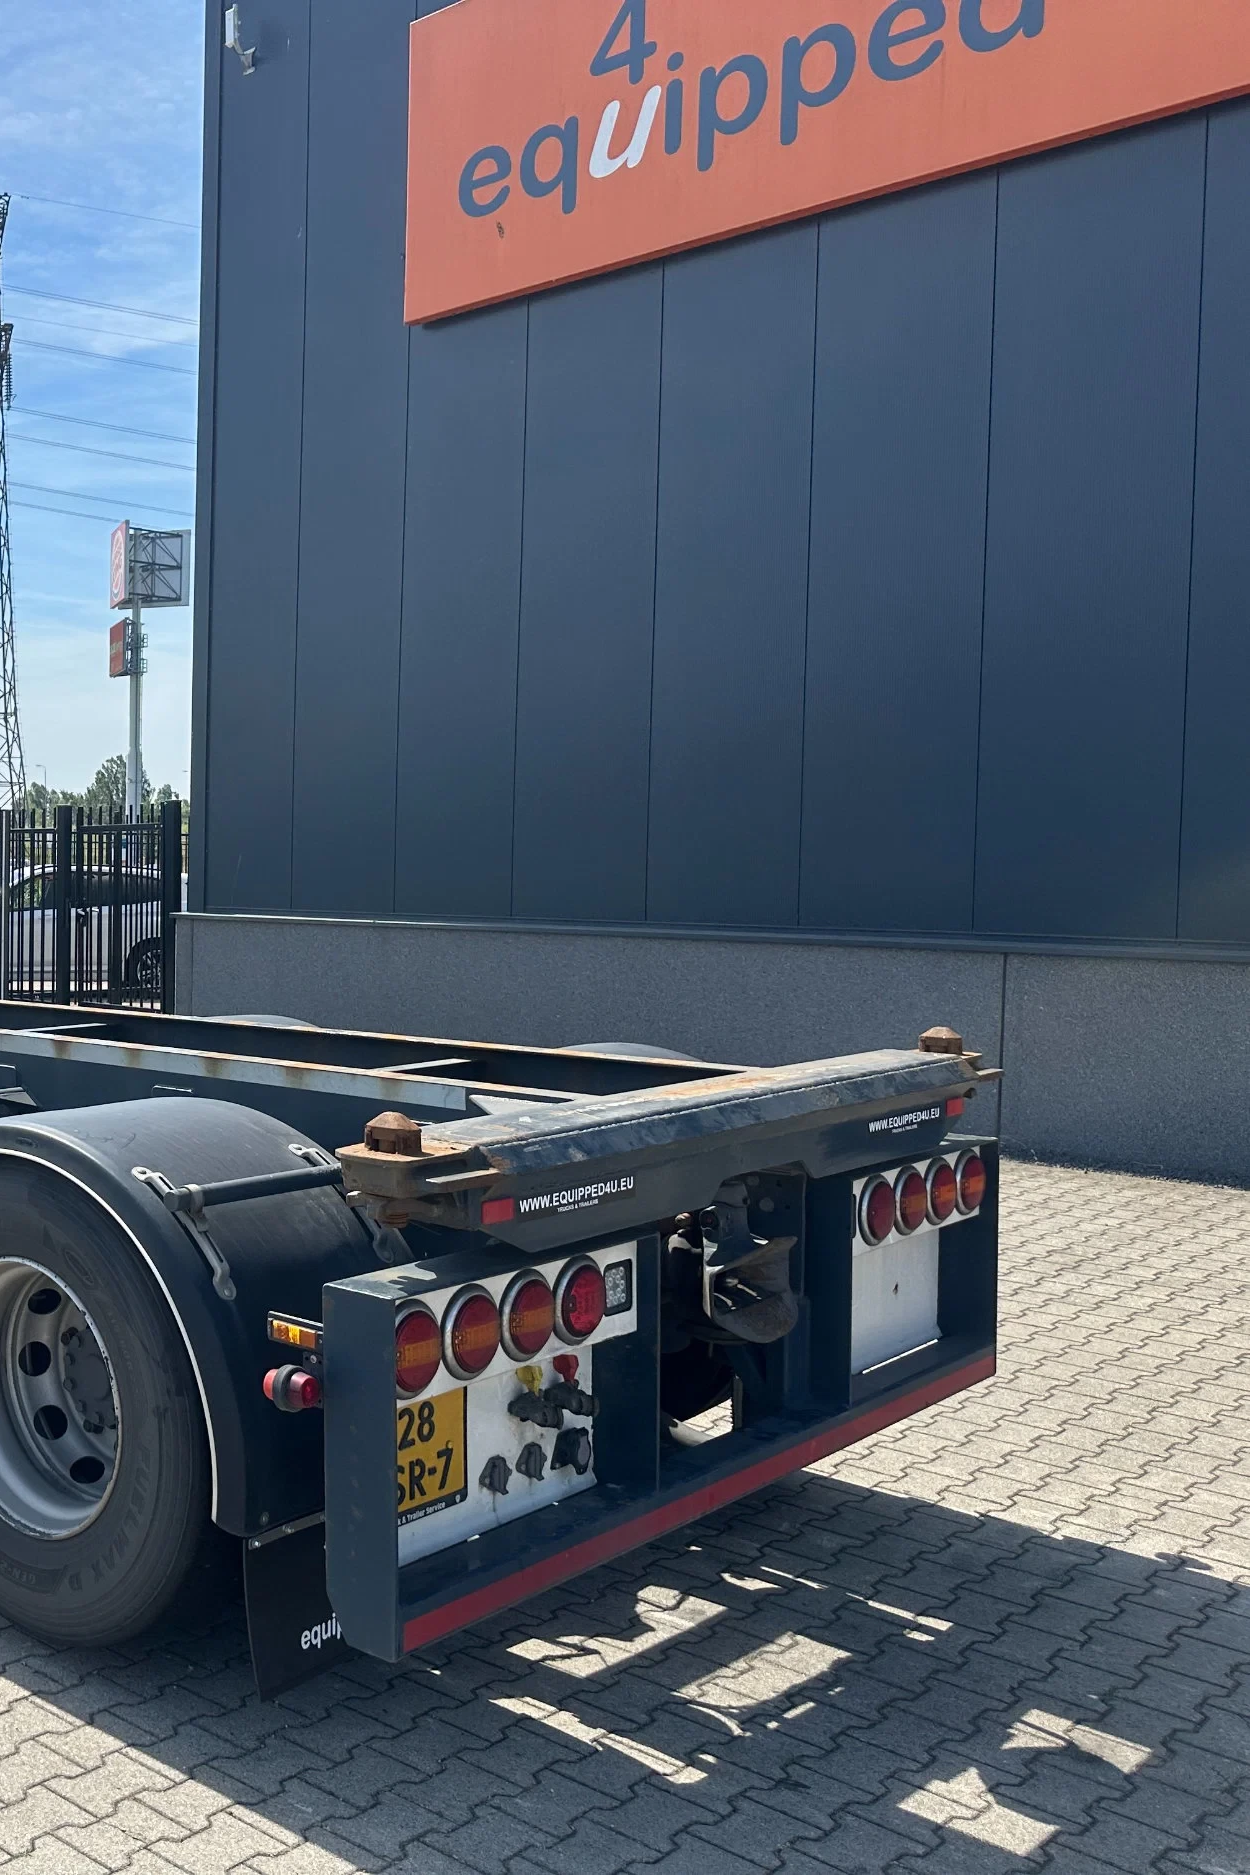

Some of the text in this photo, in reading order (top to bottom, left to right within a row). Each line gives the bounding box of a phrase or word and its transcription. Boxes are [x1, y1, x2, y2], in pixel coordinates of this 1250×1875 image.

[588, 0, 658, 85] 4
[868, 1106, 940, 1133] WWW.EQUIPPED4U.EU
[519, 1176, 634, 1213] WWW.EQUIPPED4U.EU
[557, 1203, 575, 1213] TRUCKS
[578, 1198, 599, 1208] TRAILERS
[398, 1401, 436, 1451] 28
[407, 1509, 426, 1522] Trailer
[426, 1501, 446, 1514] Service
